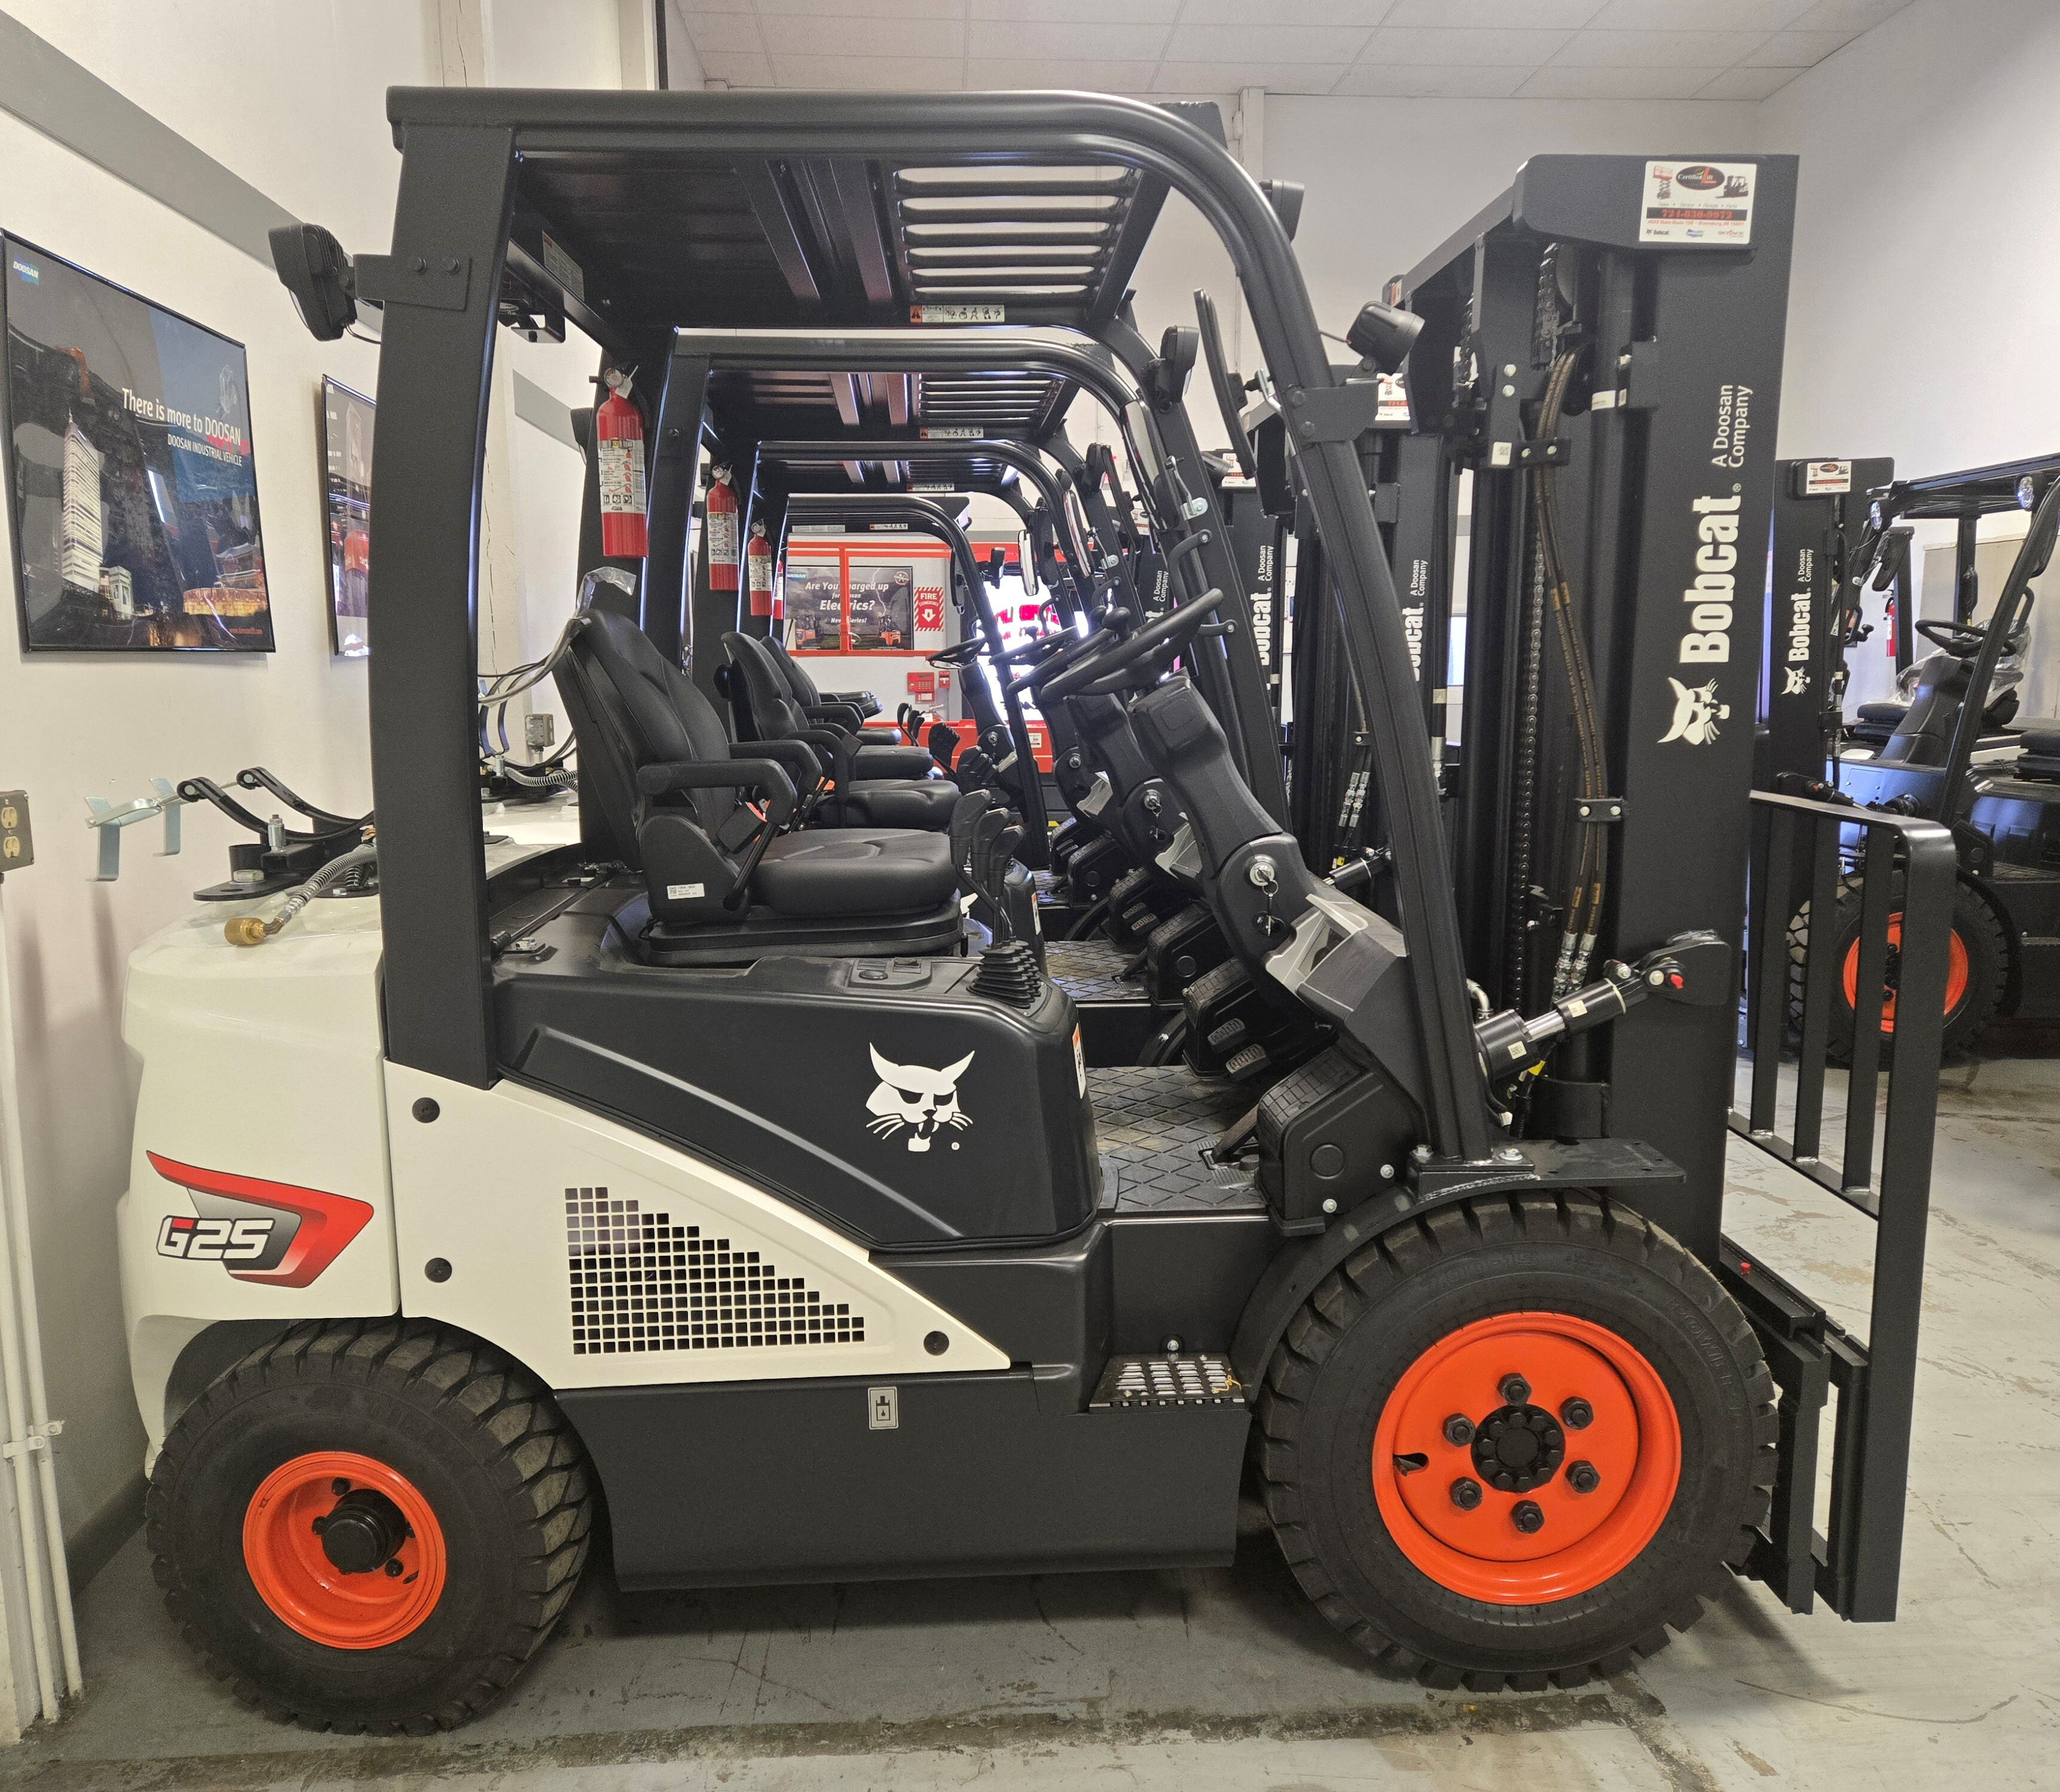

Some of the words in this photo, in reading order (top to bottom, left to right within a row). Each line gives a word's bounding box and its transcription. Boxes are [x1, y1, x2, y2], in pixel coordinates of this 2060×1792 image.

[13, 261, 39, 279] DOOSAN
[122, 387, 153, 417] There
[156, 398, 165, 421] is
[167, 407, 191, 430] more
[194, 414, 203, 433] to
[205, 417, 241, 445] DOOSAN
[1713, 385, 1734, 449] Doosan
[1728, 385, 1753, 467] Company
[167, 433, 191, 451] DOOSAN
[192, 442, 223, 461] INDUSTRIAL
[223, 451, 242, 467] VEHICLE
[1712, 454, 1727, 467] A
[1258, 545, 1267, 574] Doosan
[1264, 546, 1274, 582] Company
[1411, 559, 1420, 588] Doosan
[1804, 549, 1814, 582] Company
[805, 582, 820, 590] Are
[823, 582, 839, 590] You
[849, 582, 876, 592] arged
[878, 583, 889, 592] up
[1154, 570, 1163, 595] Doosan
[1159, 571, 1169, 602] Company
[1417, 559, 1428, 596] Company
[1680, 495, 1741, 663] Bobcat
[1789, 592, 1811, 662] Bobcat
[157, 1214, 276, 1260] G25
